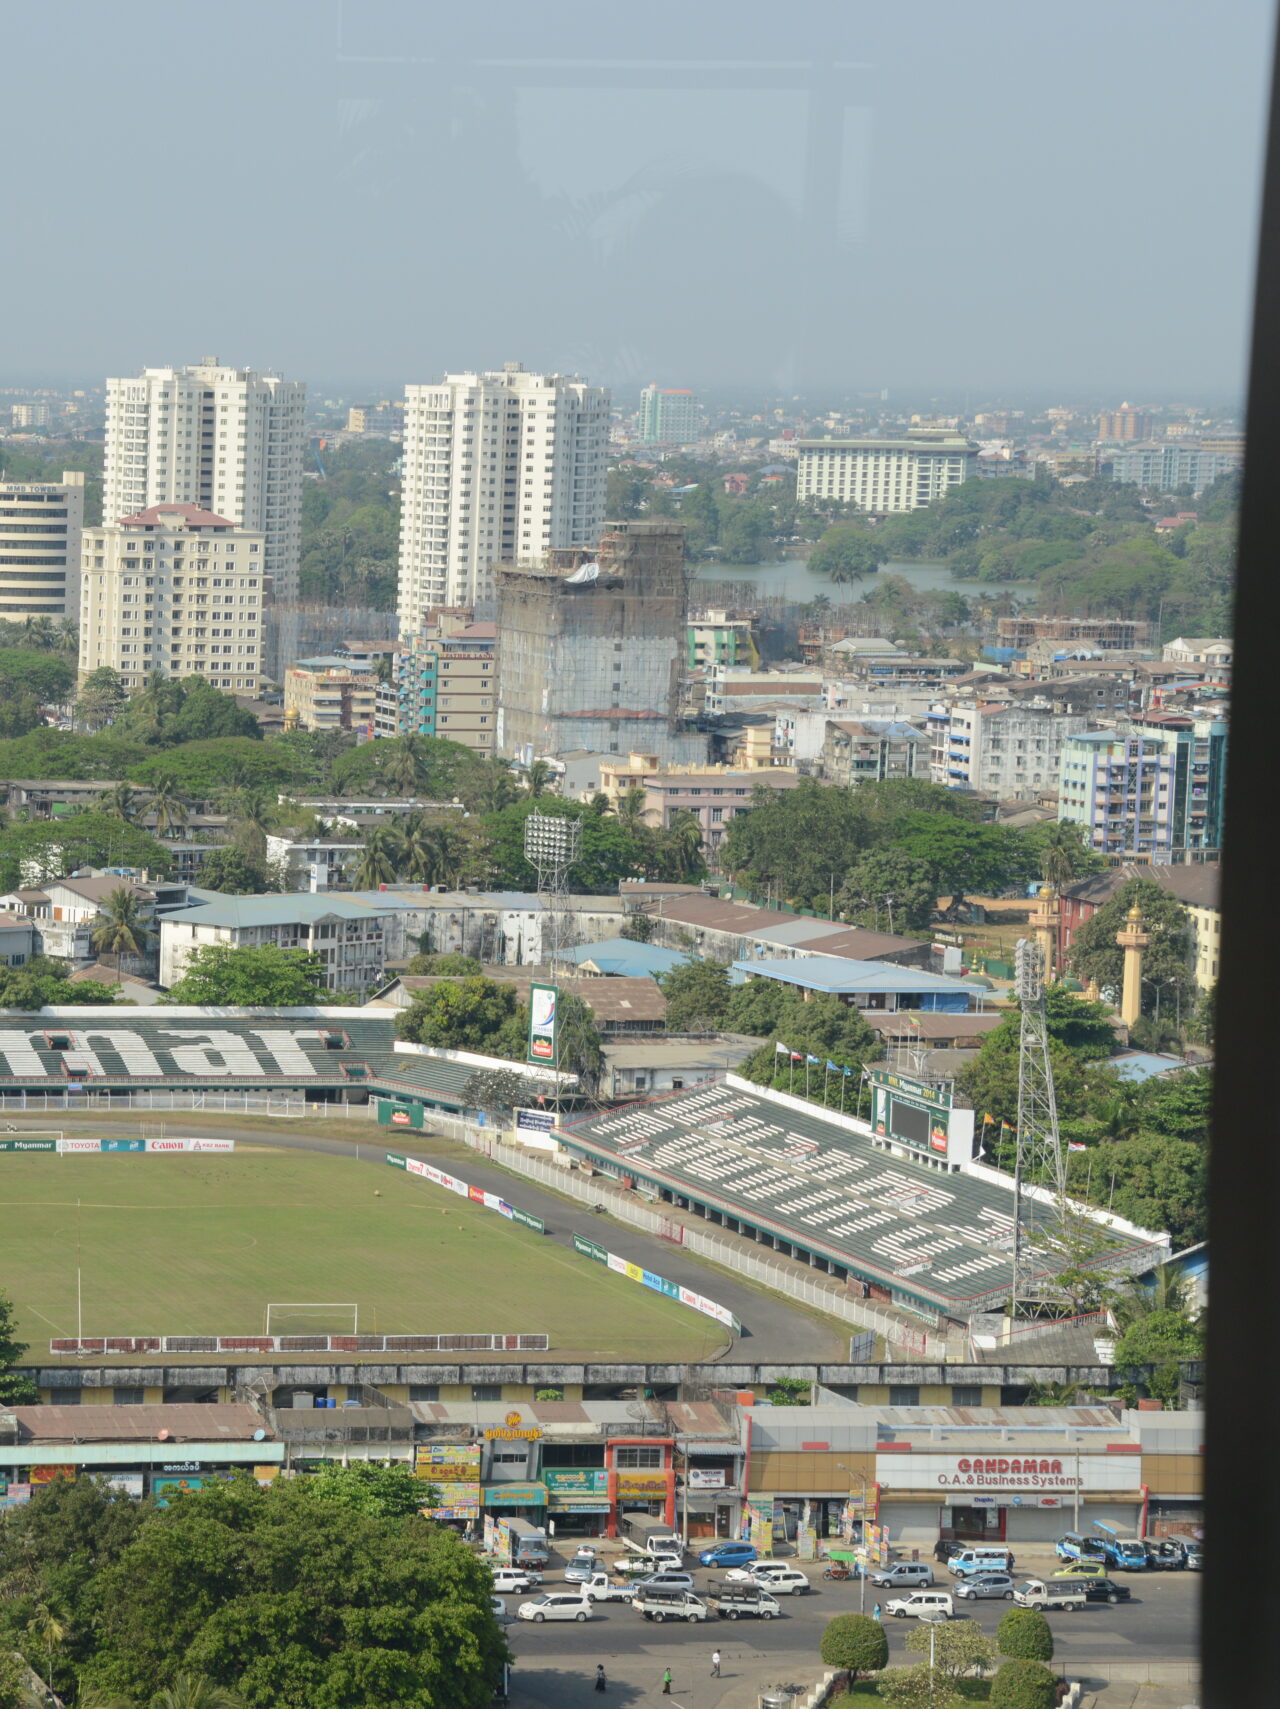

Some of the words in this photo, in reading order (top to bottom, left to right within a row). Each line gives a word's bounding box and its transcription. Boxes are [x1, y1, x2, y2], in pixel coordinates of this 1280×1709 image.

[29, 485, 57, 493] TOWER
[14, 1141, 52, 1149] Myanmar
[151, 1141, 184, 1149] Canon
[976, 1474, 1030, 1486] Business
[1031, 1474, 1084, 1488] Systems
